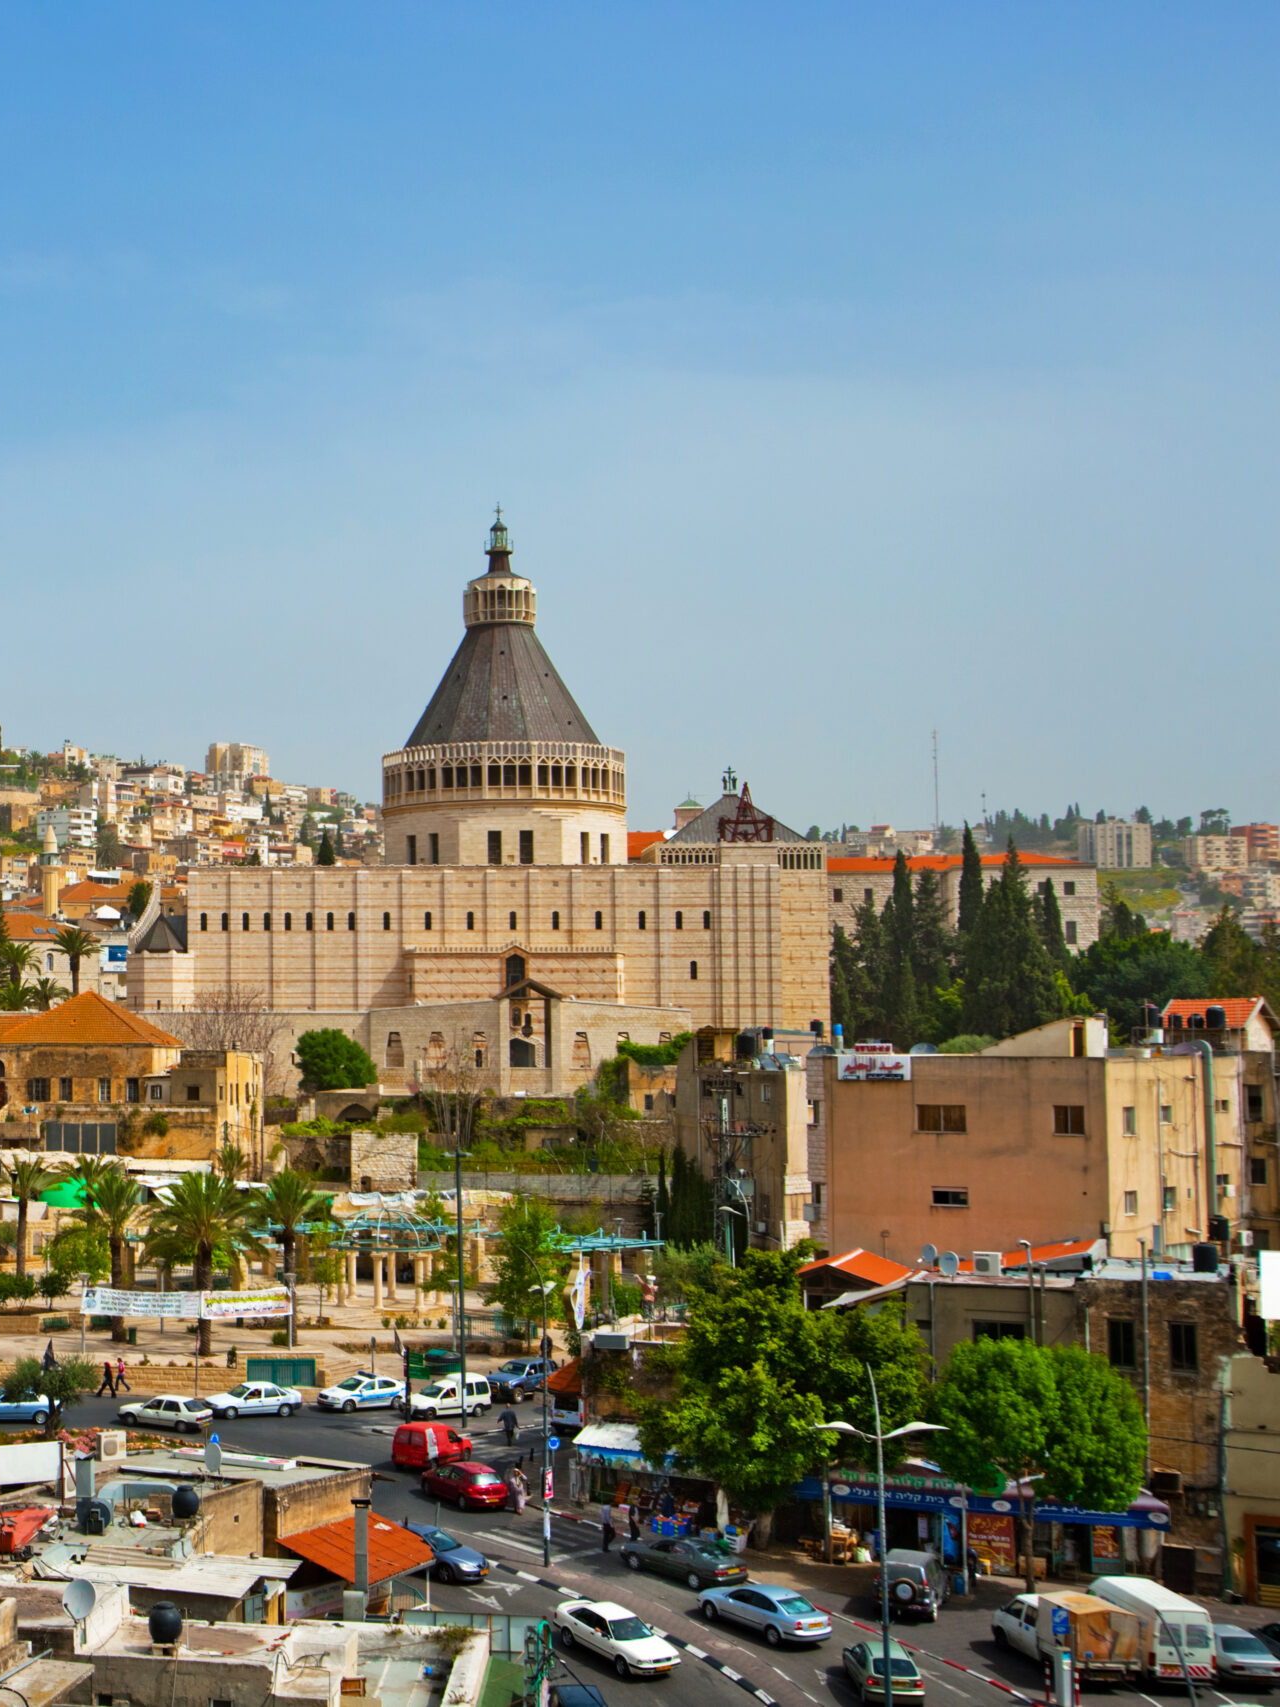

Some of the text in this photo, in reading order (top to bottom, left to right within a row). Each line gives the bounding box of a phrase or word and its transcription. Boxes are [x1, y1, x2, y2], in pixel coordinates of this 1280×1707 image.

[852, 1485, 871, 1497] עלי
[895, 1491, 922, 1503] קליה
[925, 1495, 945, 1504] בית
